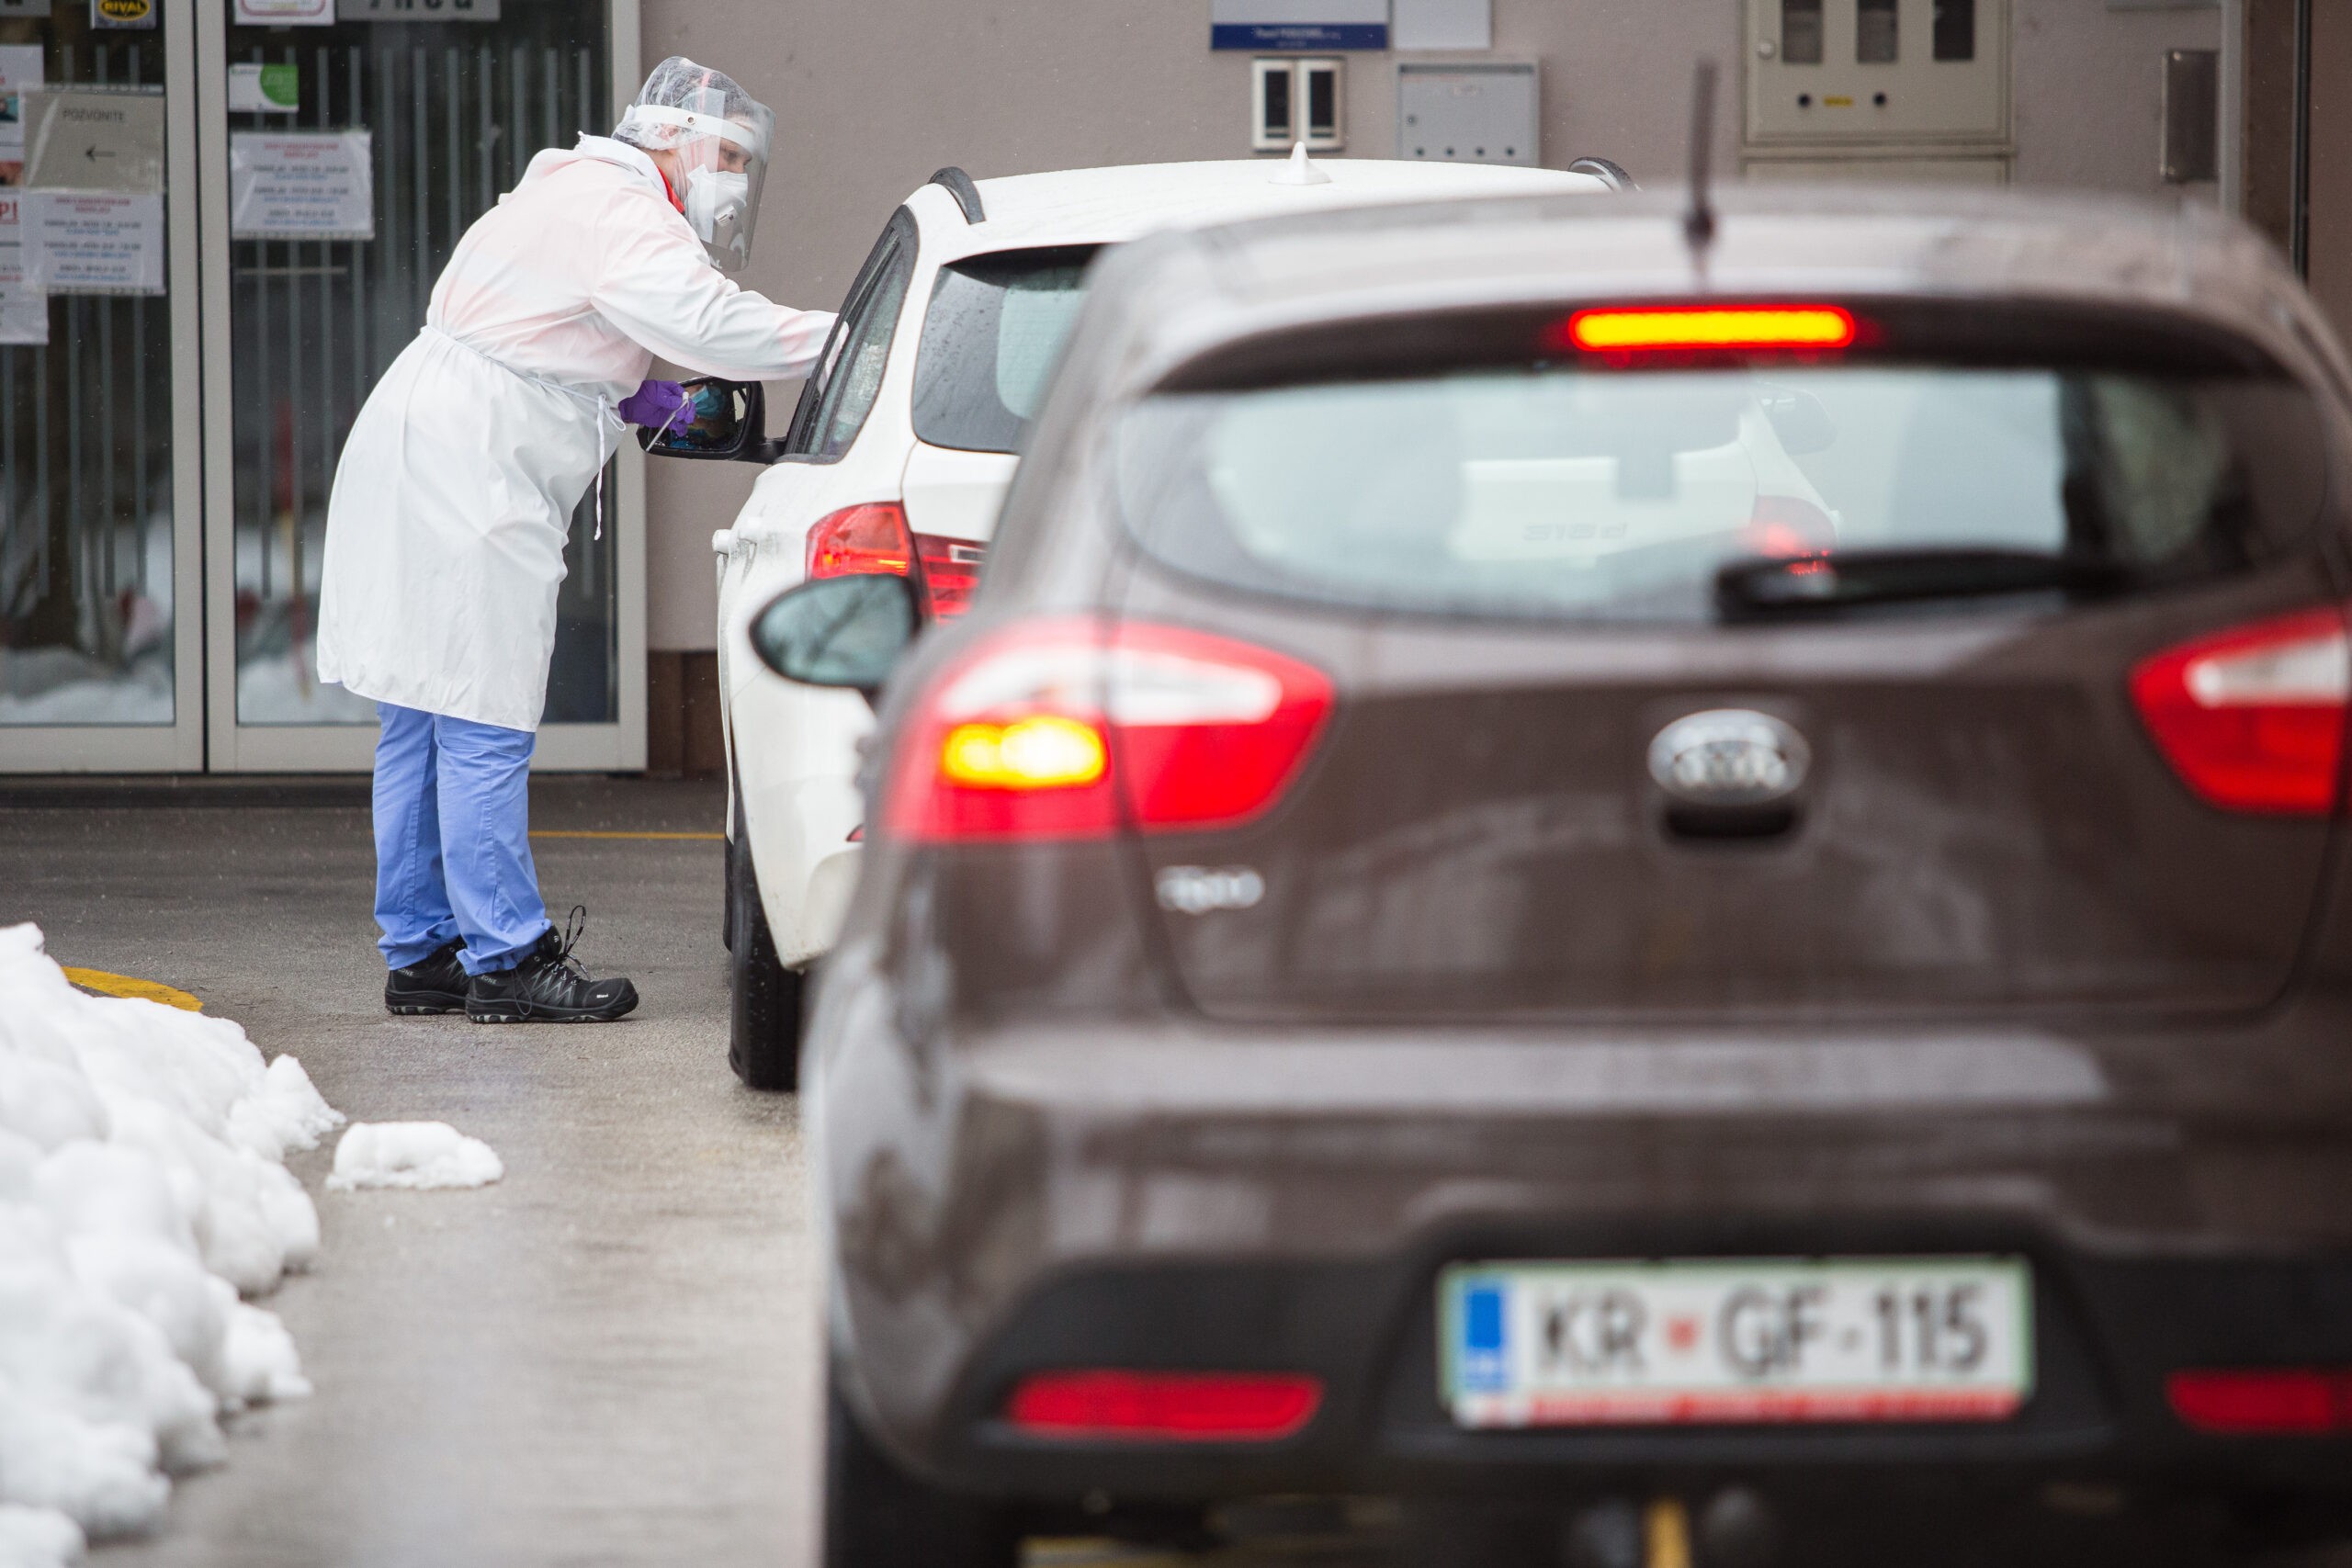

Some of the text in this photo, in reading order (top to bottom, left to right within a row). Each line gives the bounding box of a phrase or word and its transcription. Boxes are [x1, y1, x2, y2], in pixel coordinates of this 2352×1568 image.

[62, 107, 126, 122] POZVONITE
[1534, 1280, 1988, 1375] KR GF-115
